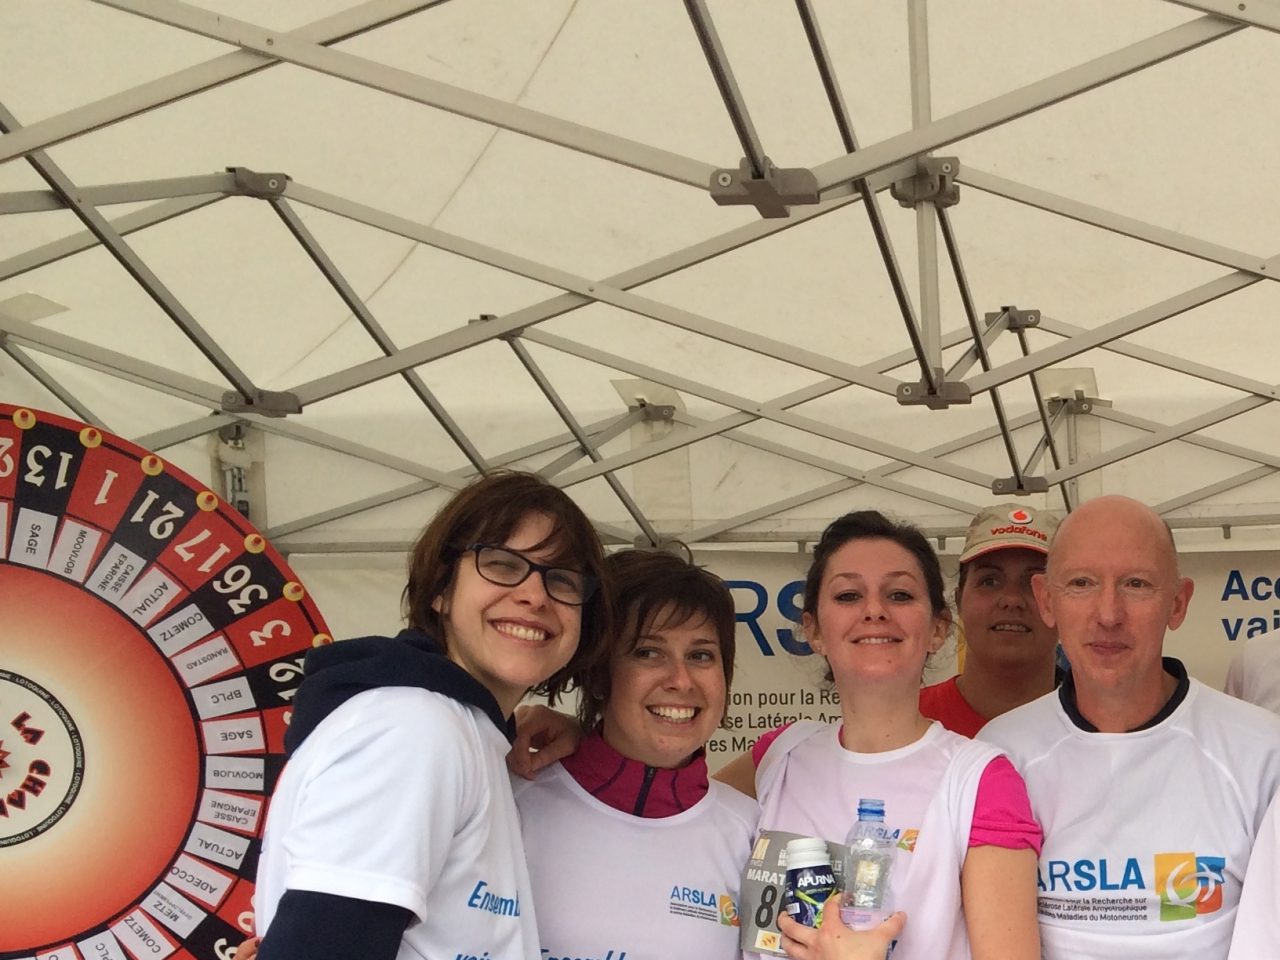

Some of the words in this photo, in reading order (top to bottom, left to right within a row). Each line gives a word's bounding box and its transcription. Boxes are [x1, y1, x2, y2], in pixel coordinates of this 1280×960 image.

[24, 445, 73, 490] 13
[94, 469, 118, 505] 1
[130, 490, 185, 540] 21
[25, 523, 41, 556] SAGE
[990, 524, 1048, 542] vodafone
[174, 529, 232, 573] 17
[98, 553, 128, 591] EPARGNE
[111, 564, 135, 593] CAISSE
[132, 581, 169, 616] ACTUAL
[213, 564, 268, 615] 36
[159, 612, 203, 642] COMETZ
[249, 619, 292, 647] 3
[186, 647, 229, 670] RANDSTAD
[211, 689, 243, 704] BPLC
[758, 692, 796, 708] pour
[800, 689, 814, 705] la
[221, 729, 253, 741] SAGE
[210, 800, 257, 817] EPARGNE
[214, 811, 249, 825] CAISSE
[198, 838, 243, 860] ACTUAL
[170, 866, 218, 894] ADECCO
[797, 874, 836, 888] APURNA
[671, 885, 717, 908] ARSLA
[153, 900, 180, 922] METZ
[124, 915, 161, 954] COMETZ
